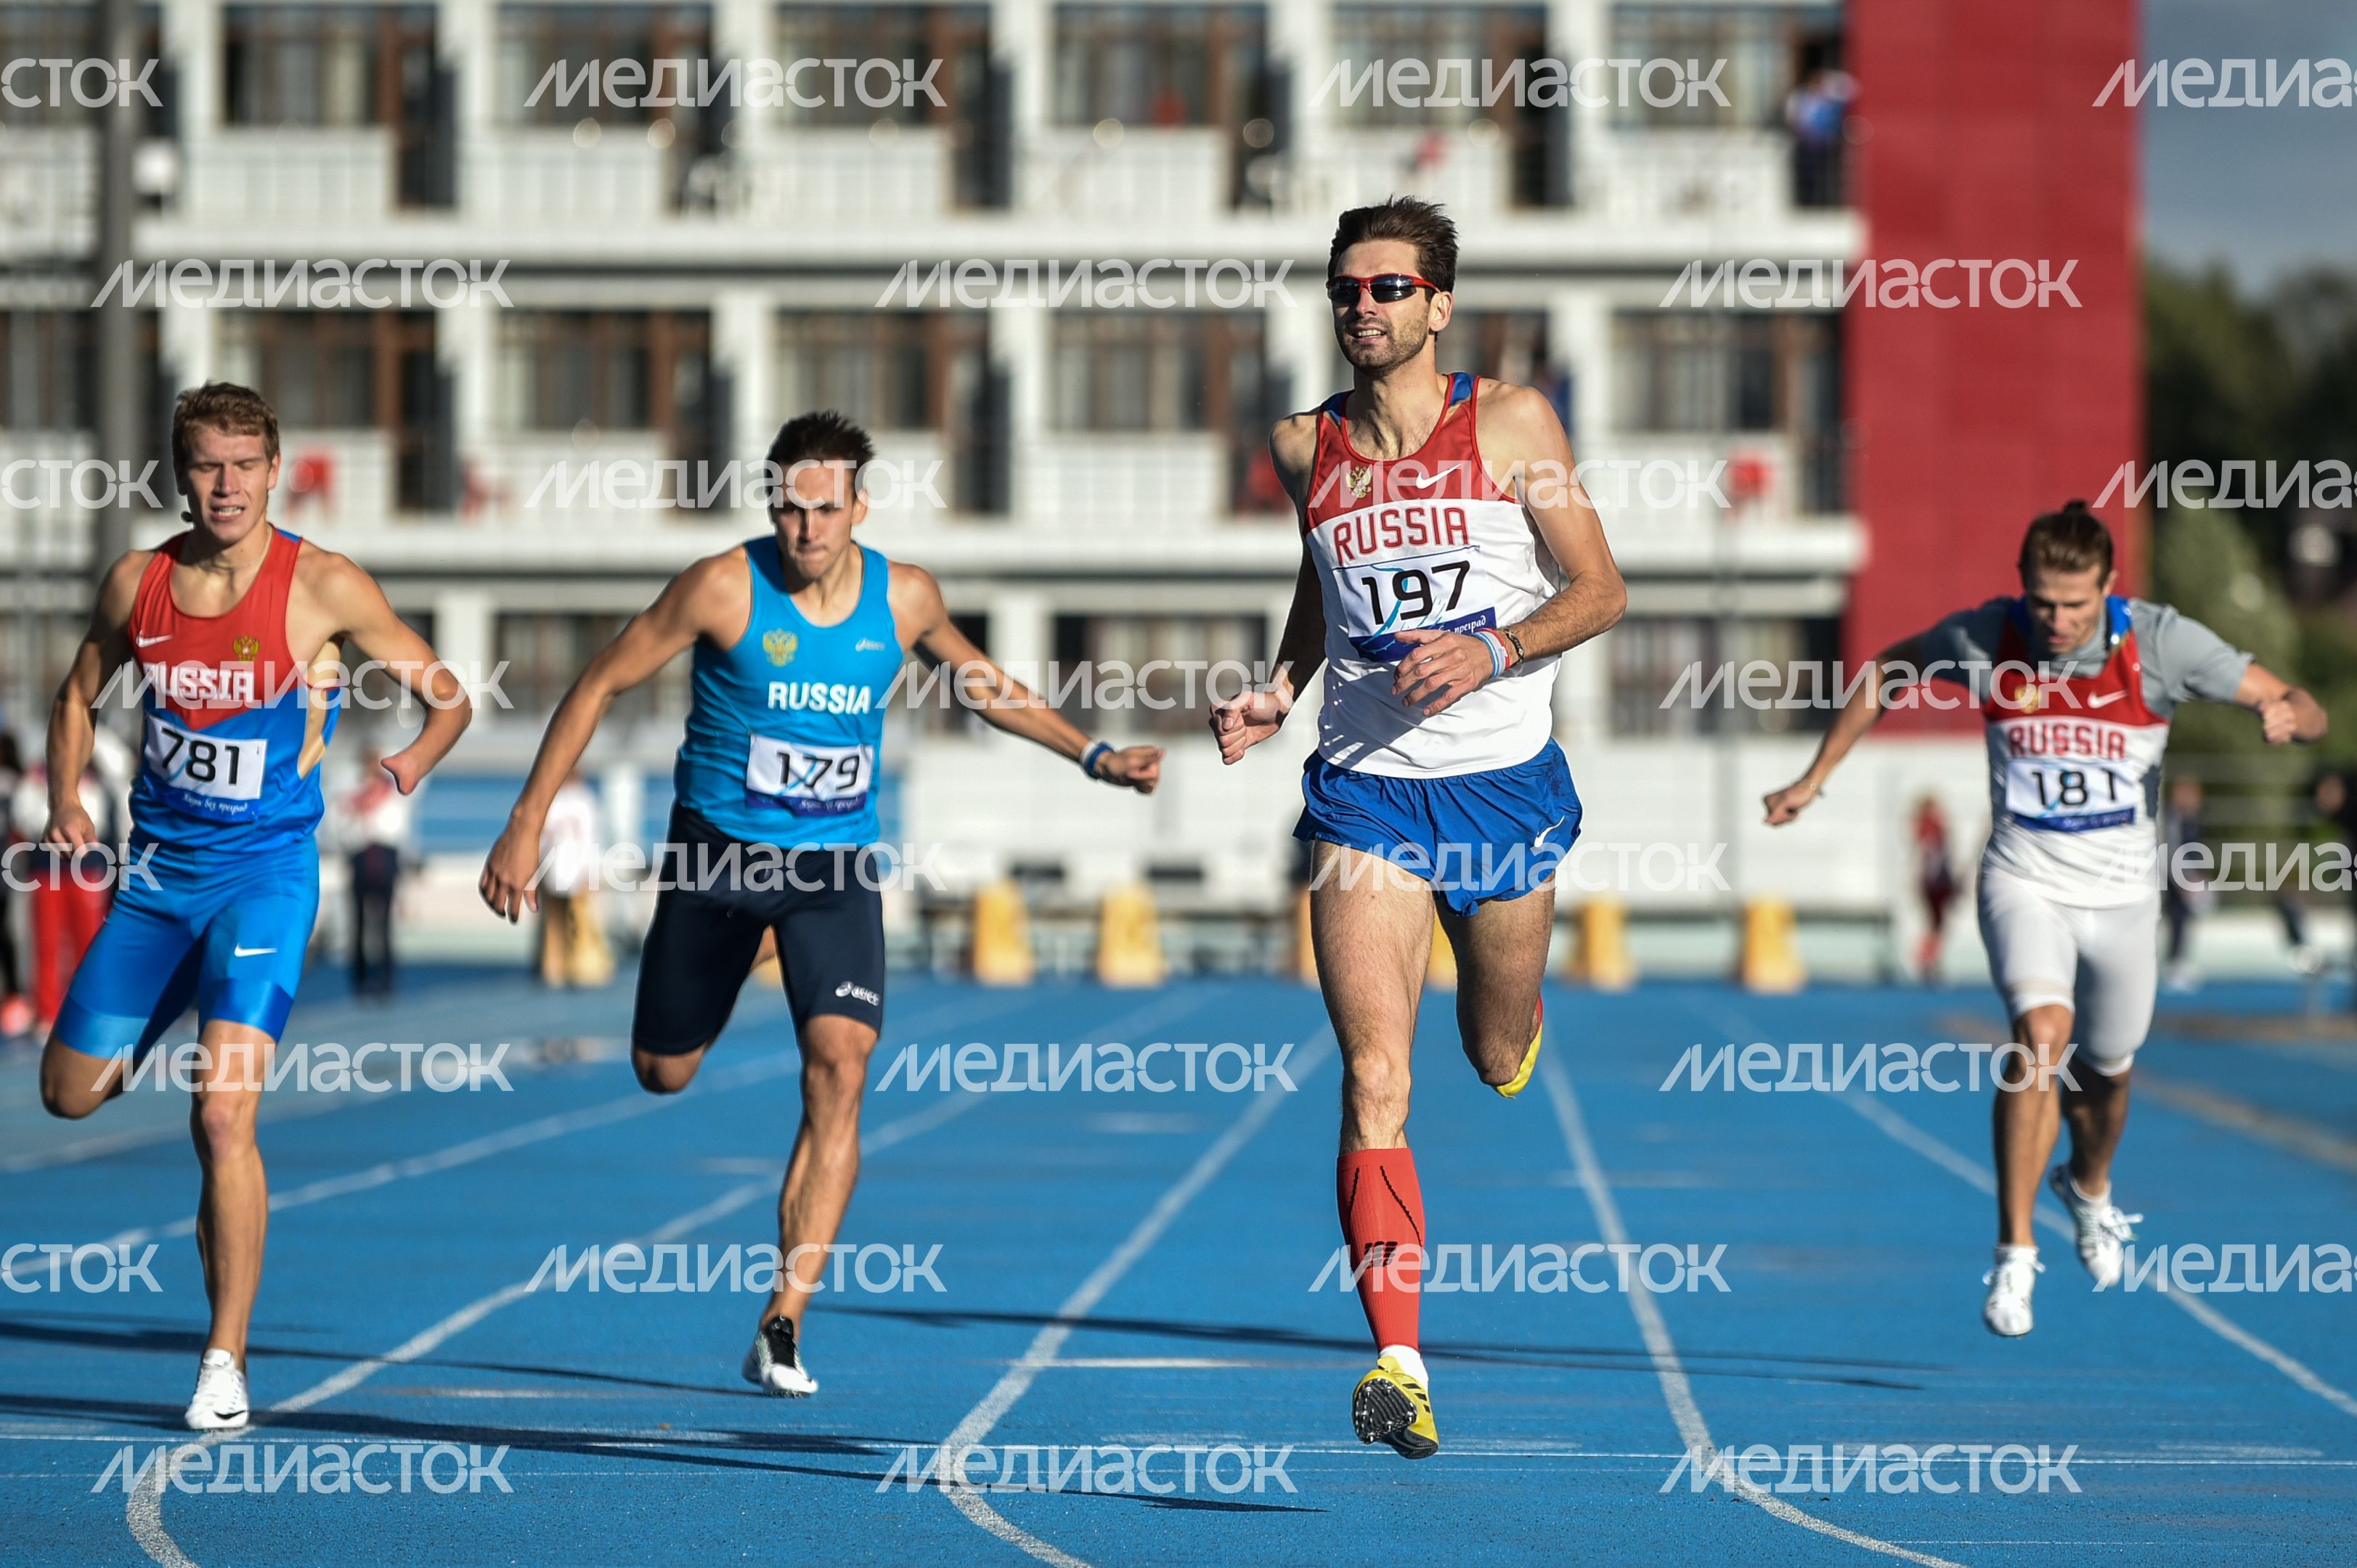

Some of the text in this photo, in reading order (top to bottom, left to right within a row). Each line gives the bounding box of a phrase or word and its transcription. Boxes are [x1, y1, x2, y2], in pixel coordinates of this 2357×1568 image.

[1333, 506, 1470, 566] RUSSIA
[1361, 560, 1470, 625] 197
[768, 681, 871, 714] RUSSIA
[161, 727, 240, 785] 781
[2008, 723, 2126, 760] RUSSIA
[777, 752, 860, 791] 179
[2032, 767, 2115, 806] 181
